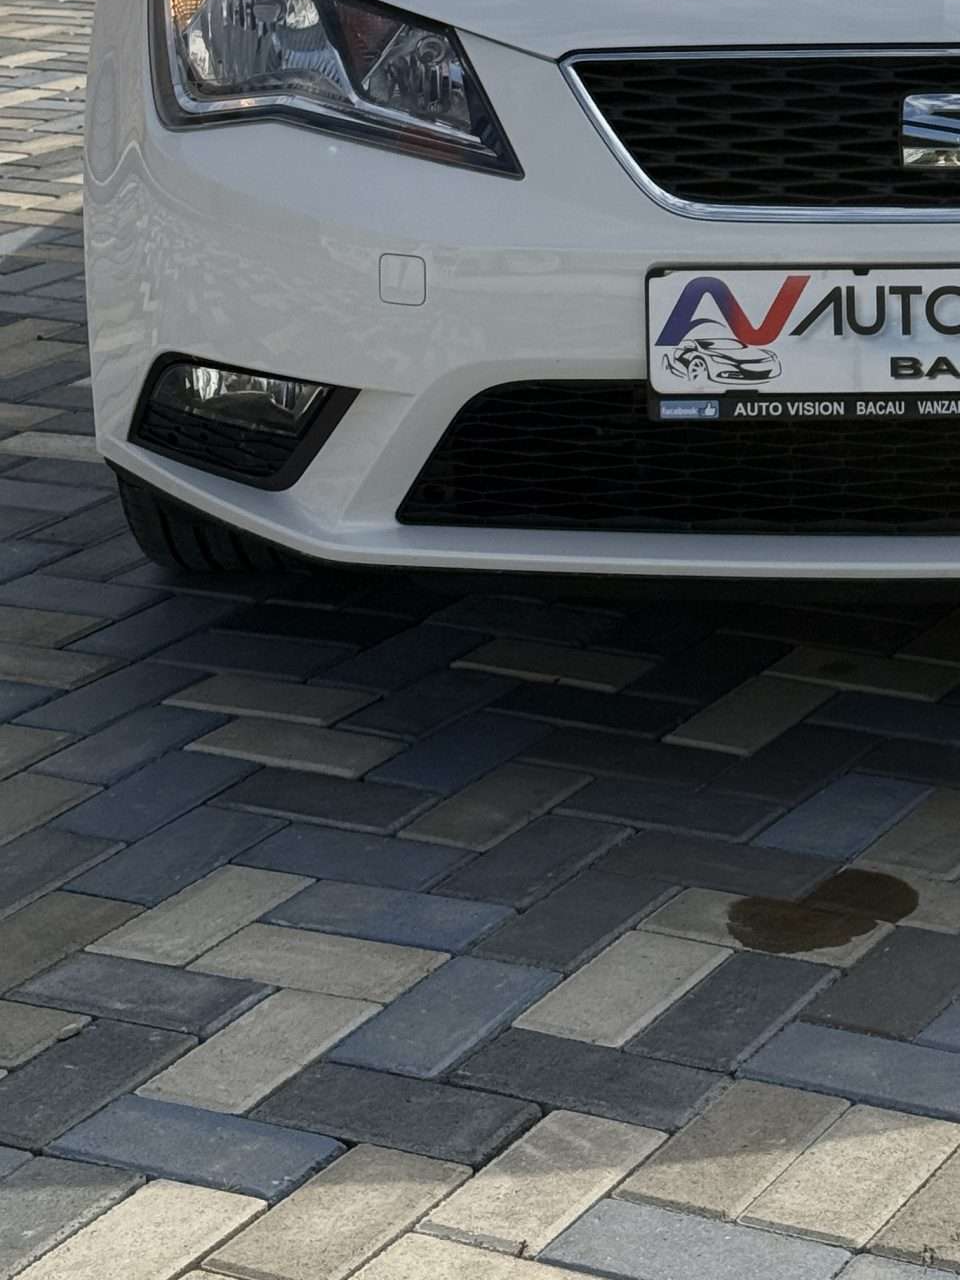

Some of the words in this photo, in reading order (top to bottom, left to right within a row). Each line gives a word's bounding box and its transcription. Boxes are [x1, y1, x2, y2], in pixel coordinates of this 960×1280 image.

[733, 402, 783, 417] AUTO
[787, 401, 845, 416] VISION
[856, 400, 905, 415] BACAU
